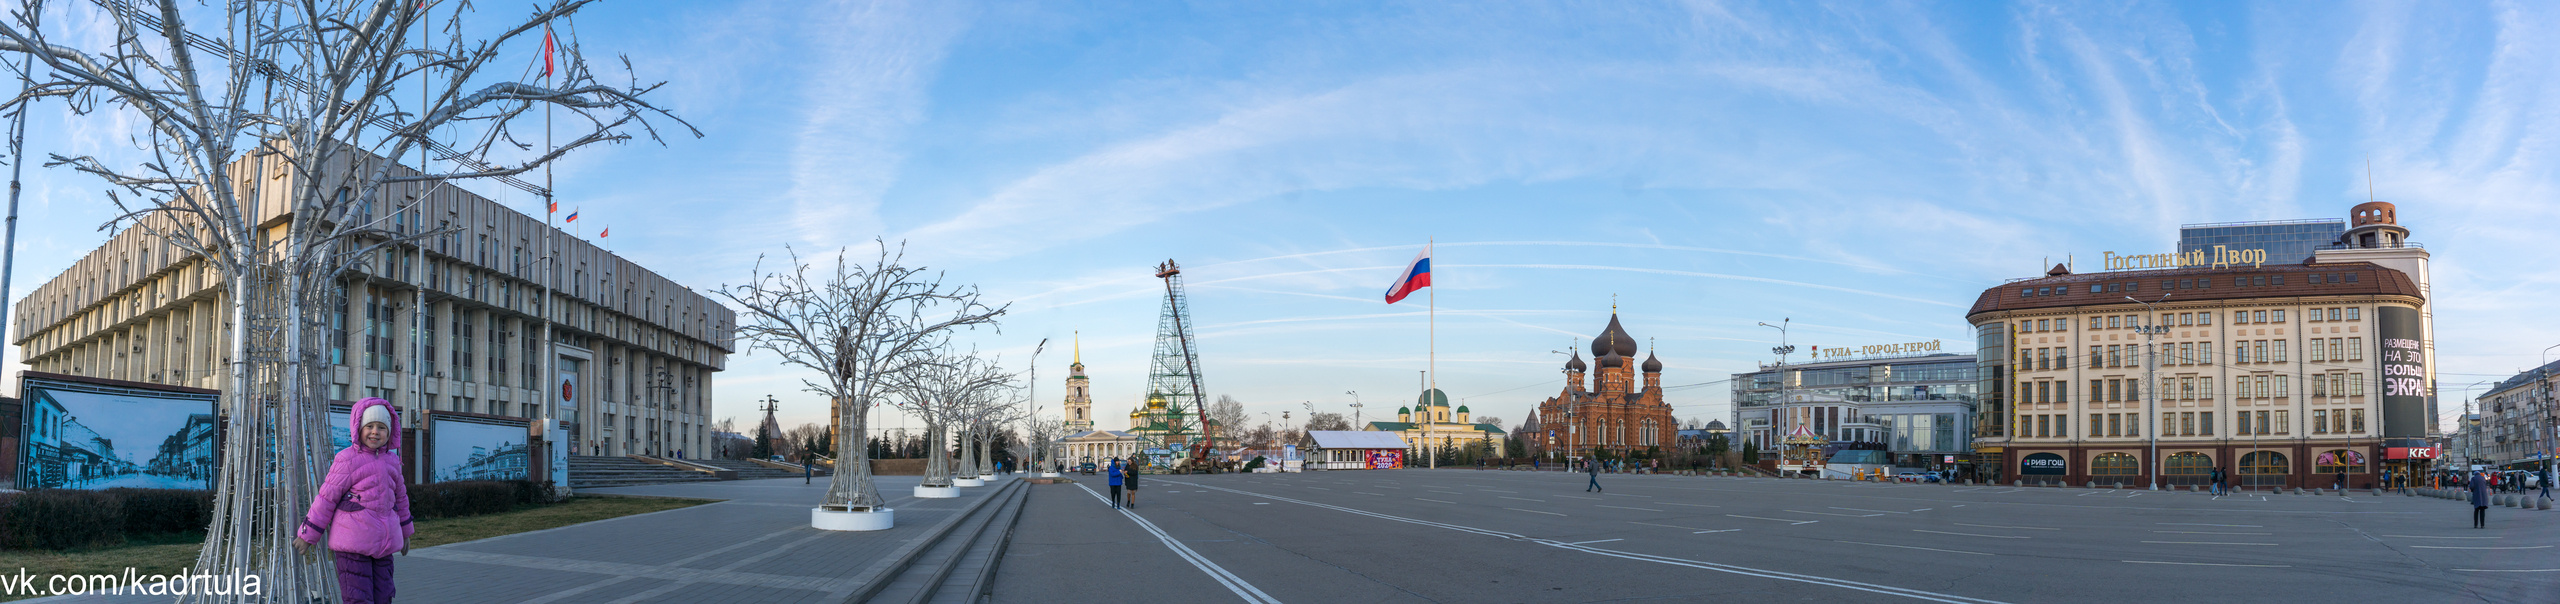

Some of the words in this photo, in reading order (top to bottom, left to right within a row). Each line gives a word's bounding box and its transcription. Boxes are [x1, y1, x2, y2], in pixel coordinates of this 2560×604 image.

[2103, 249, 2204, 270] Гостиный
[2212, 245, 2267, 269] Двор
[1823, 347, 1851, 357] ТУЛА
[1862, 339, 1941, 355] ГОРОД-ГЕРОЙ
[2384, 350, 2402, 362] НА
[2409, 448, 2431, 458] KFC
